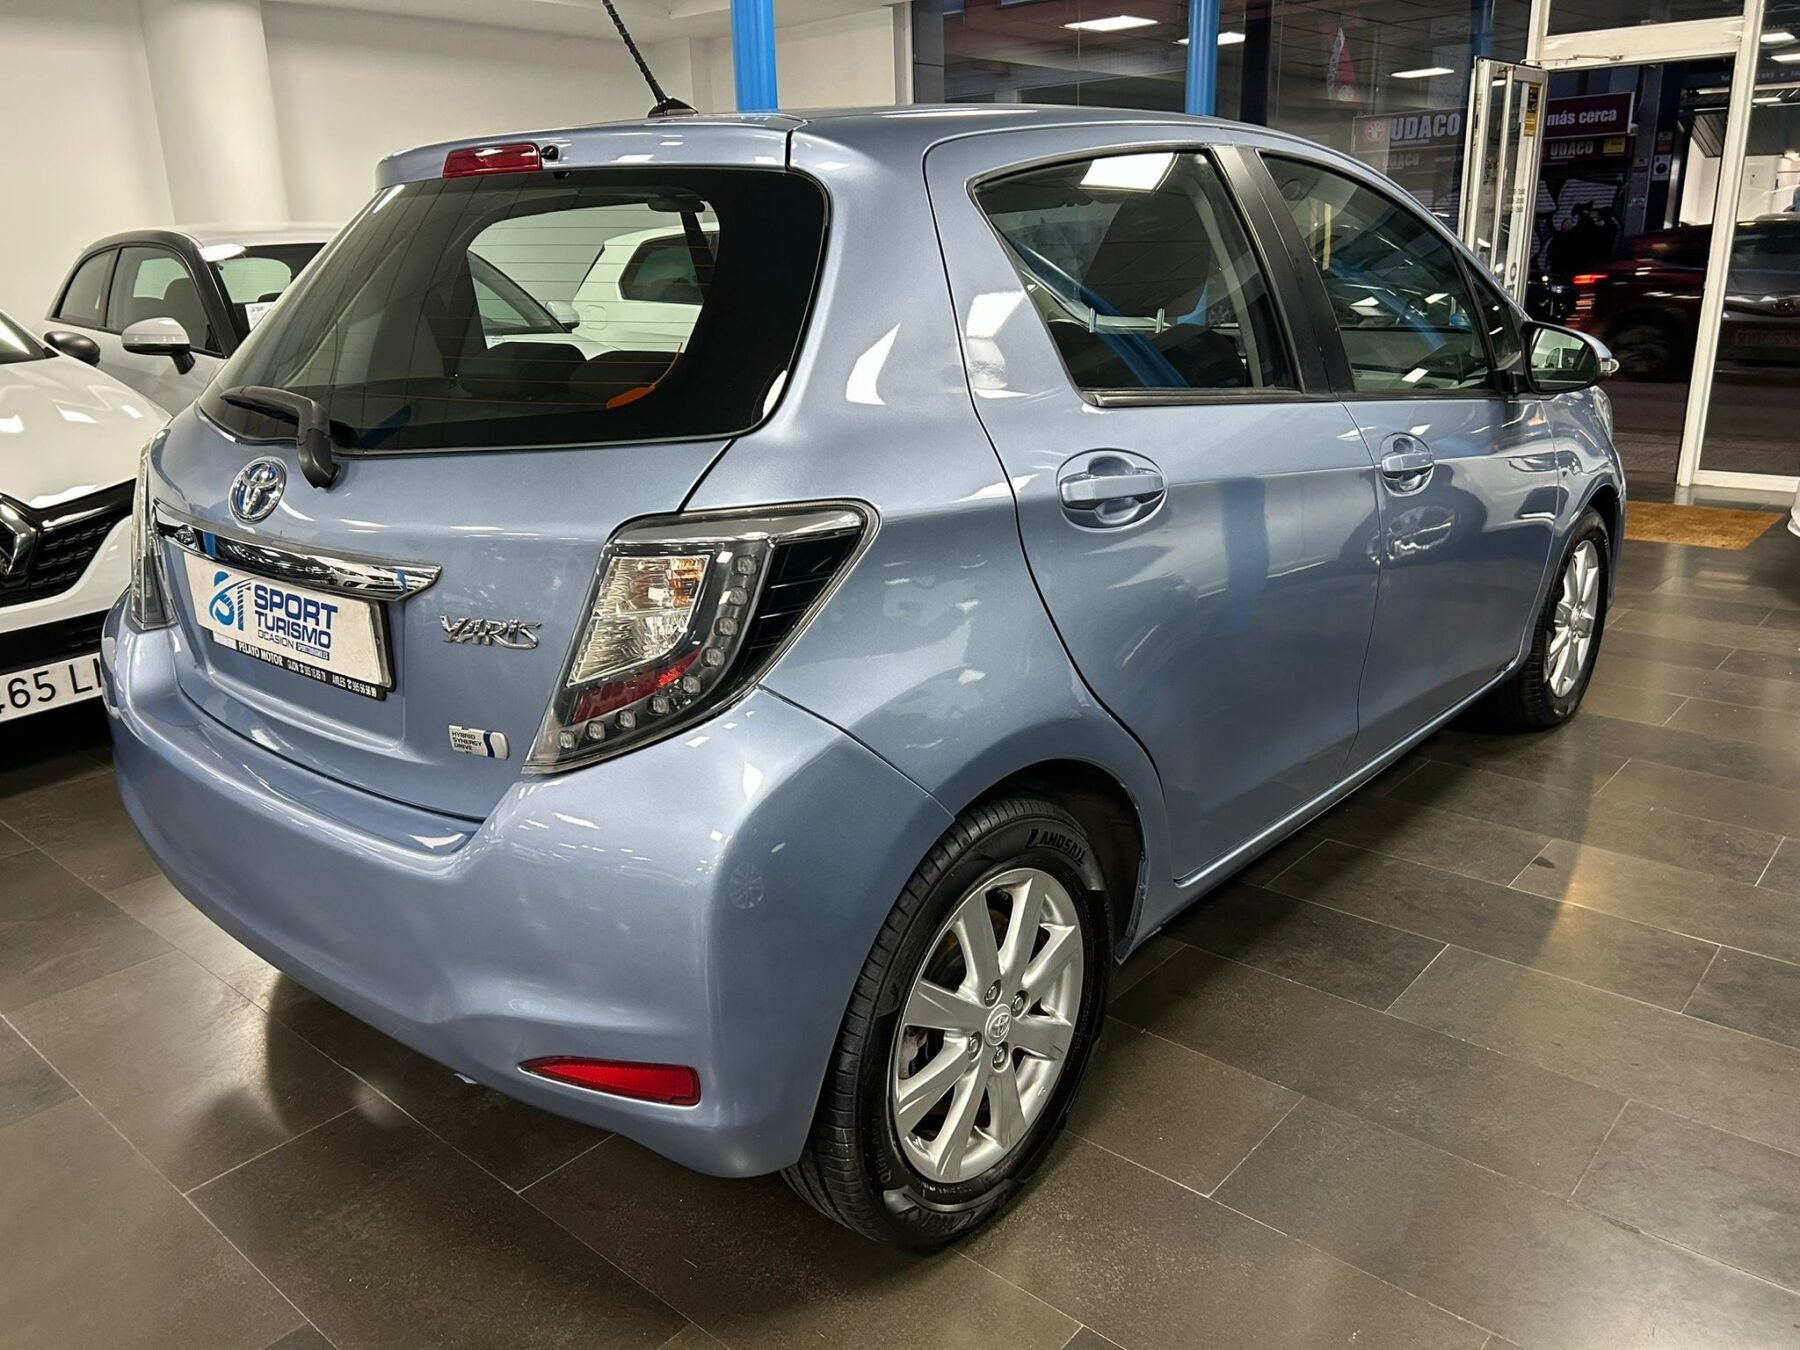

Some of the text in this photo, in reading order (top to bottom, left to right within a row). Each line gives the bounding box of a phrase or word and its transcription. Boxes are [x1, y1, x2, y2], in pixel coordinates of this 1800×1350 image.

[1391, 112, 1461, 140] UDACO
[1546, 108, 1617, 126] más cerca
[1550, 140, 1594, 157] UDACO
[254, 583, 338, 630] SPORT
[254, 609, 331, 649] TURISMO
[257, 629, 294, 649] OCASION
[260, 649, 284, 667] MOTOR
[0, 670, 56, 713] 65
